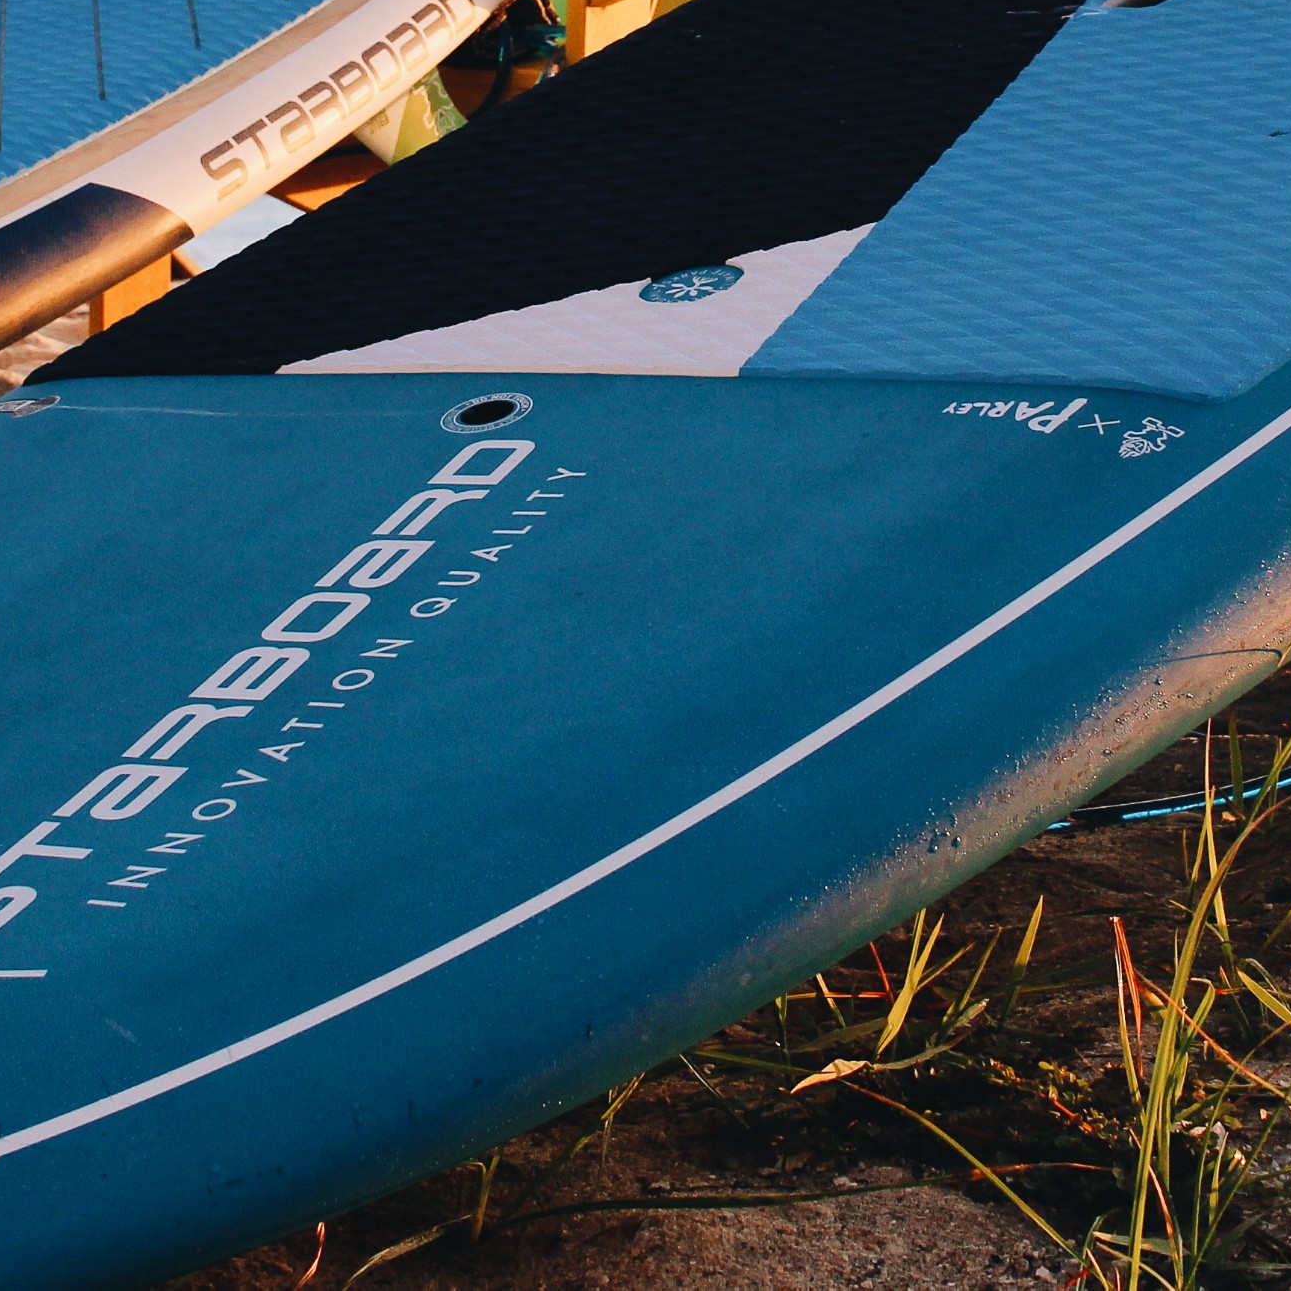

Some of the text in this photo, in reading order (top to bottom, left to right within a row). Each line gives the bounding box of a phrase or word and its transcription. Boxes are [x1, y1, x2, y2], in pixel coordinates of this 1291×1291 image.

[942, 398, 1088, 434] PARLEY
[87, 467, 587, 908] INNOVATION QUALITY
